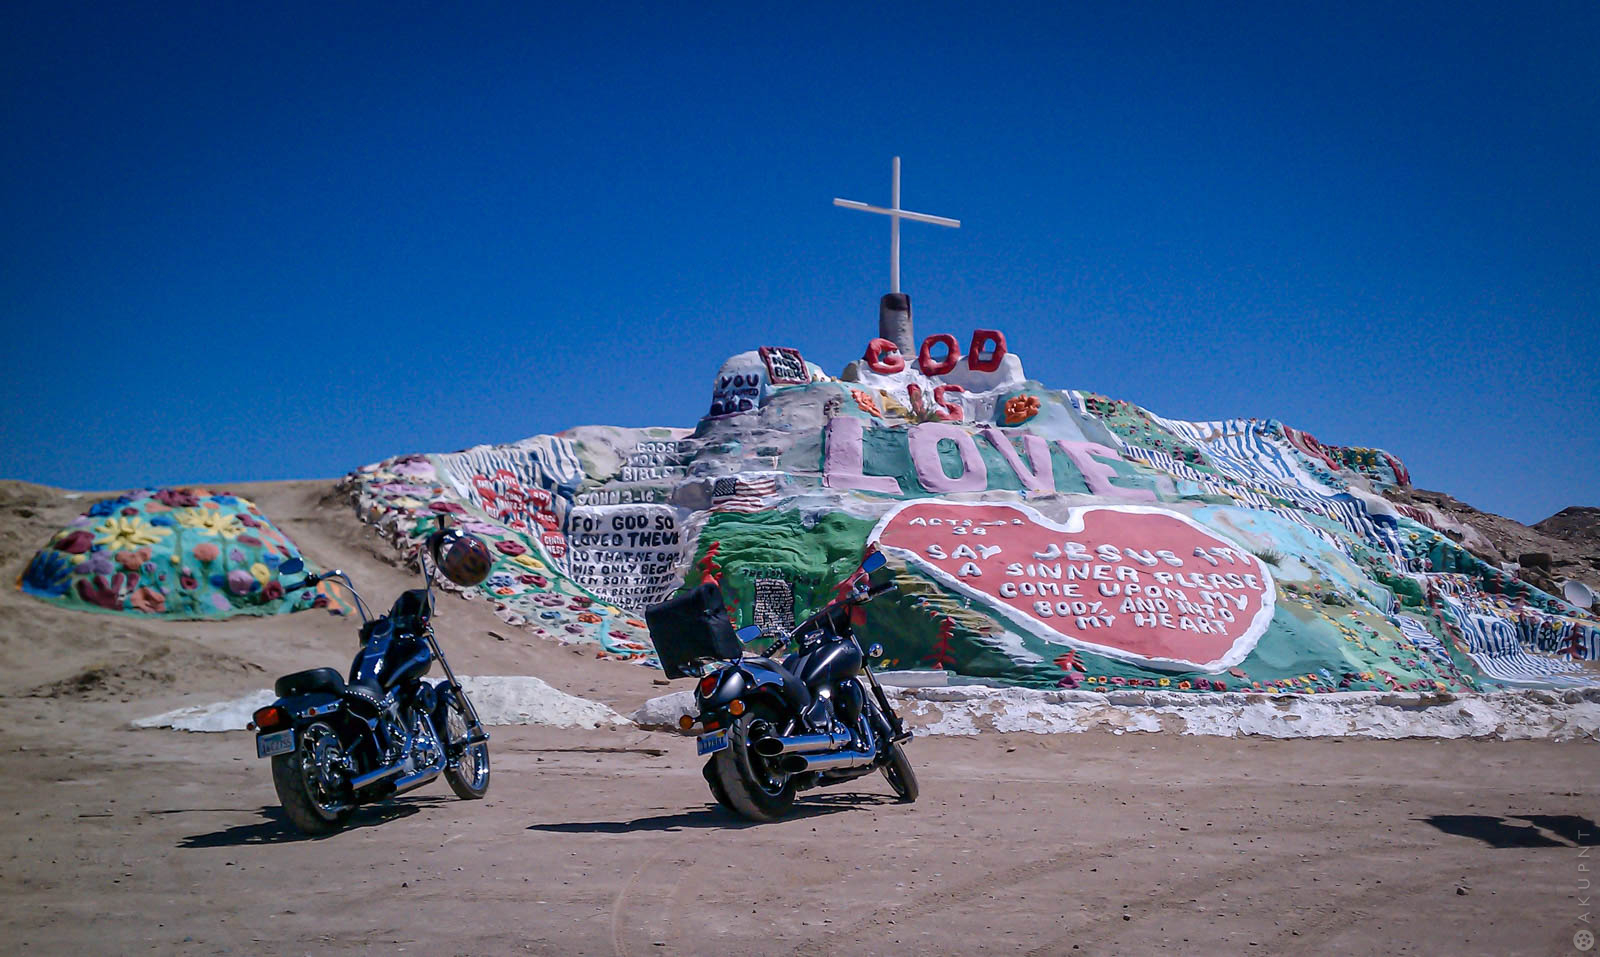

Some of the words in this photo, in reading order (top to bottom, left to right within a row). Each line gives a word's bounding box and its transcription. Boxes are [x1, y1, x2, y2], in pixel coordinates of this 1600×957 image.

[864, 329, 1007, 376] GOD
[721, 375, 759, 388] YOU
[907, 383, 967, 422] IS
[822, 416, 1158, 500] LOVE
[577, 491, 620, 505] JOHN
[612, 515, 648, 530] GOD
[655, 515, 675, 530] SO
[908, 517, 974, 527] ACTS
[952, 526, 987, 536] 38
[572, 533, 624, 547] LOVED
[926, 543, 1002, 560] SAY
[1032, 541, 1184, 567] JESUS
[572, 564, 596, 575] HIS
[601, 564, 637, 574] ONLY
[957, 561, 983, 577] A
[1005, 562, 1141, 583] SINNER
[1153, 571, 1263, 591] PLEASE
[603, 576, 628, 585] SON
[1000, 582, 1084, 599] COME
[1098, 582, 1188, 602] UPON
[1199, 590, 1250, 612] MY
[1119, 597, 1170, 615] AND
[1176, 600, 1237, 624] INTO
[1075, 613, 1117, 631] MY
[1134, 612, 1230, 637] HEART
